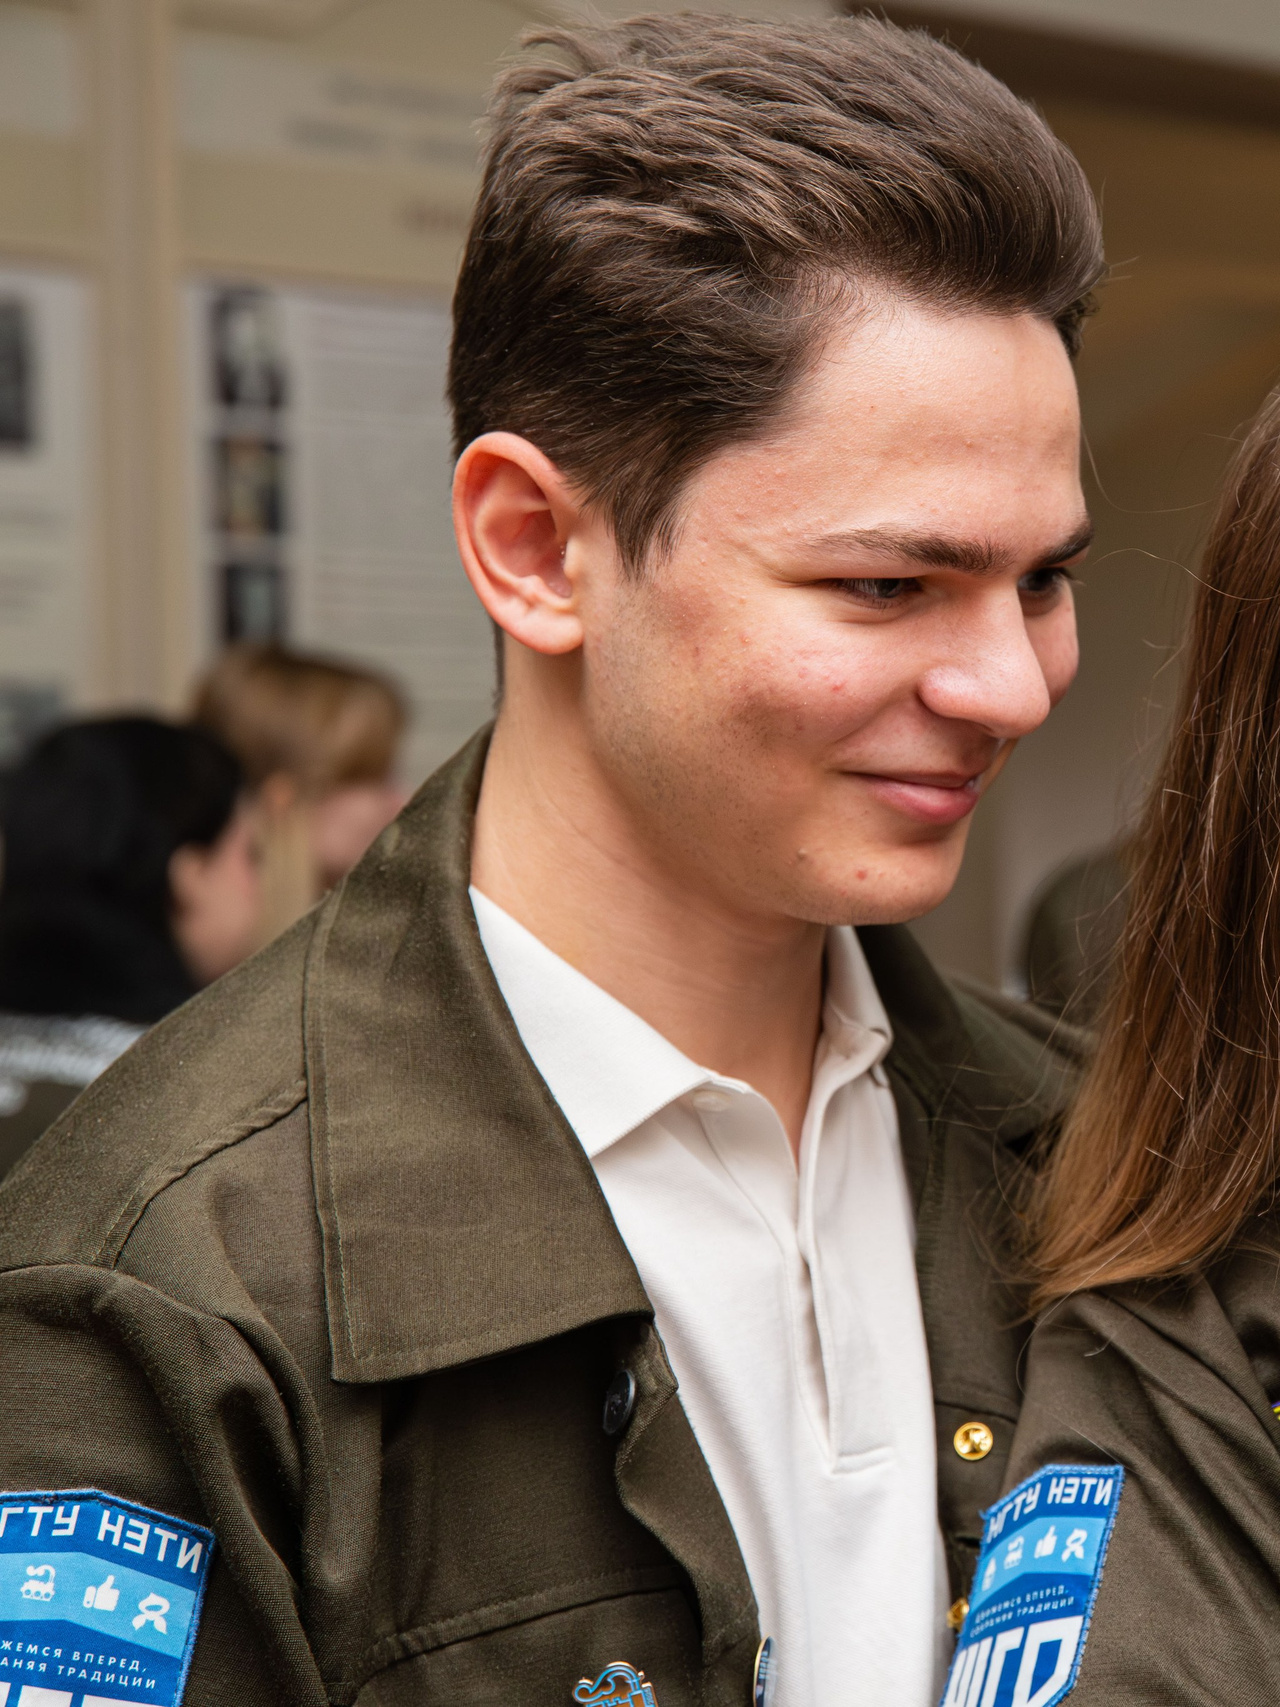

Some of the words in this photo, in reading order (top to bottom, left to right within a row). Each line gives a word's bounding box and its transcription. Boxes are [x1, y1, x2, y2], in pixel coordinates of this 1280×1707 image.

[986, 1482, 1041, 1543] НГТУ
[1047, 1477, 1114, 1506] НЭТИ
[97, 1509, 203, 1574] НЭТИ
[1017, 1596, 1074, 1617] ТРАДИЦИИ
[72, 1651, 147, 1673] ВПЕРЕД,
[57, 1665, 156, 1690] ТРАДИЦИИ
